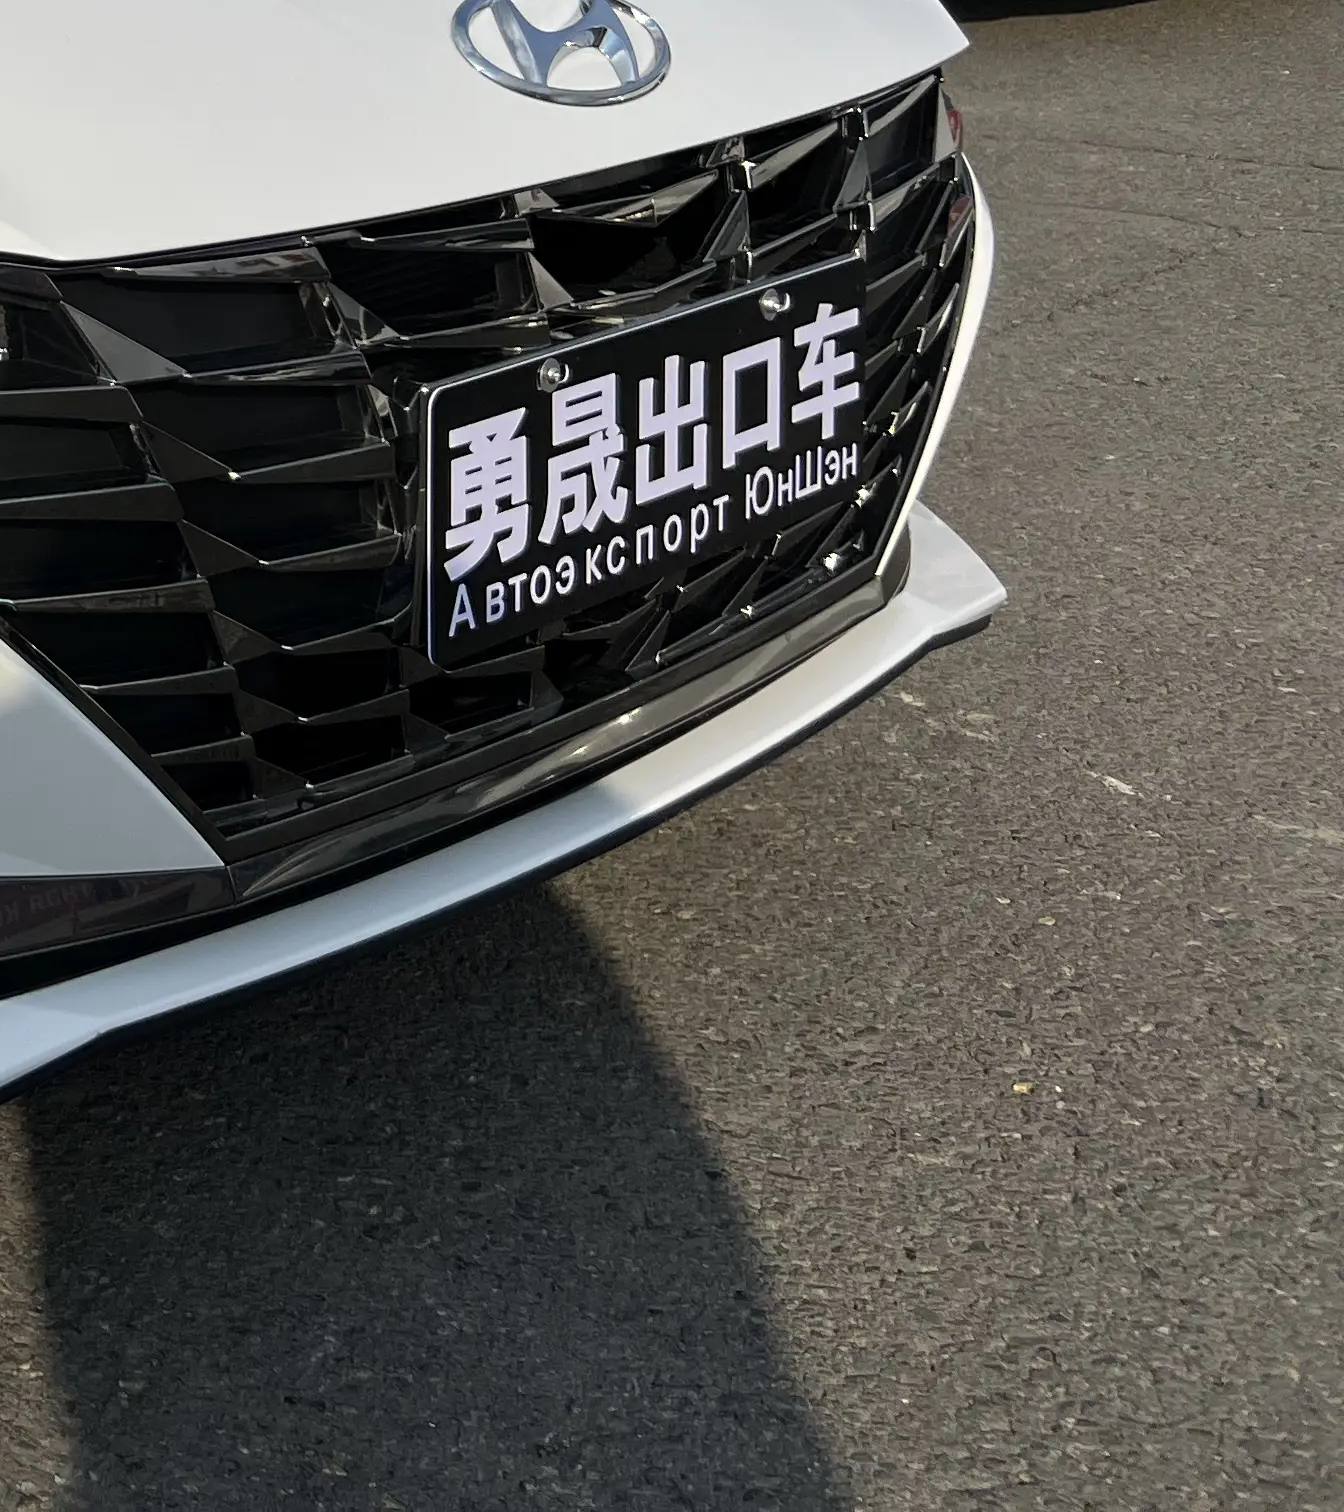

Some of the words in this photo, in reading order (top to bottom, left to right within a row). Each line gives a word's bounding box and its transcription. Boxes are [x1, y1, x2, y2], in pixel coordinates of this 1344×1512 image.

[443, 303, 860, 581] 勇晟出口车
